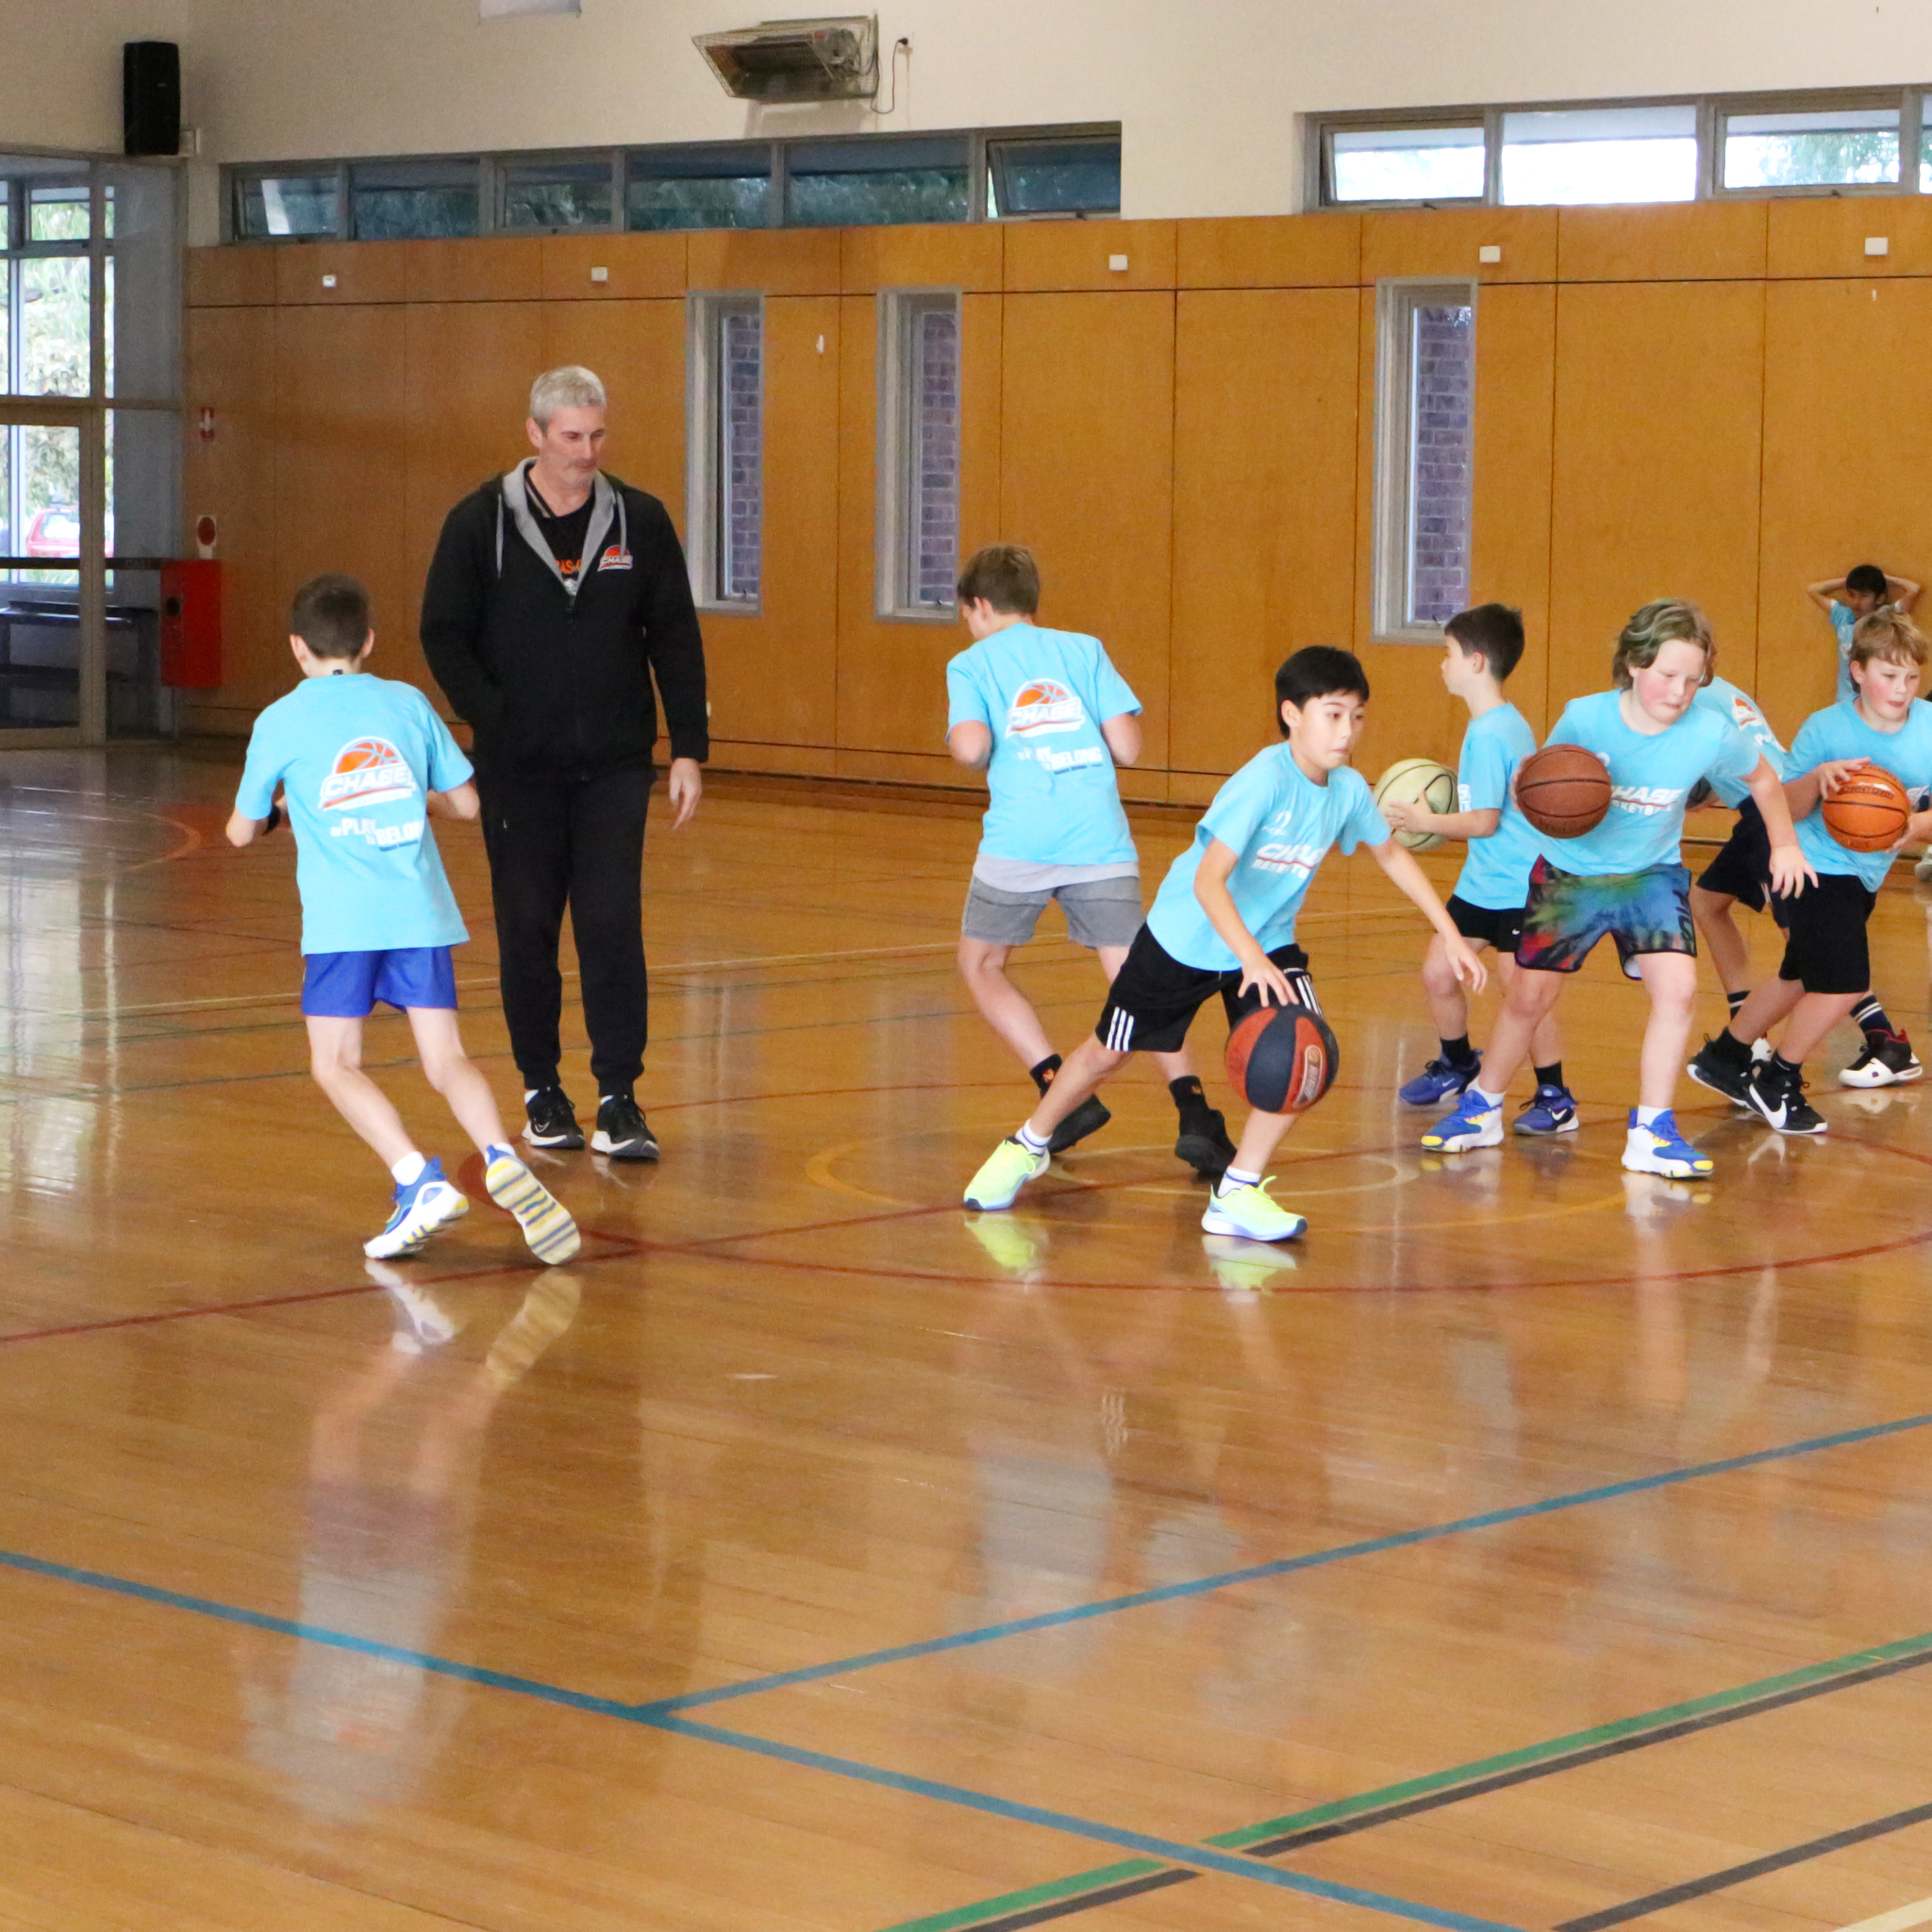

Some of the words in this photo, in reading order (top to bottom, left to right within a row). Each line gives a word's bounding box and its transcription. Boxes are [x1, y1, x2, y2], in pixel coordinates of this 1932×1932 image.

[1010, 701, 1077, 724] CHASE
[324, 765, 408, 796] CHASE
[1610, 785, 1685, 806] HASE
